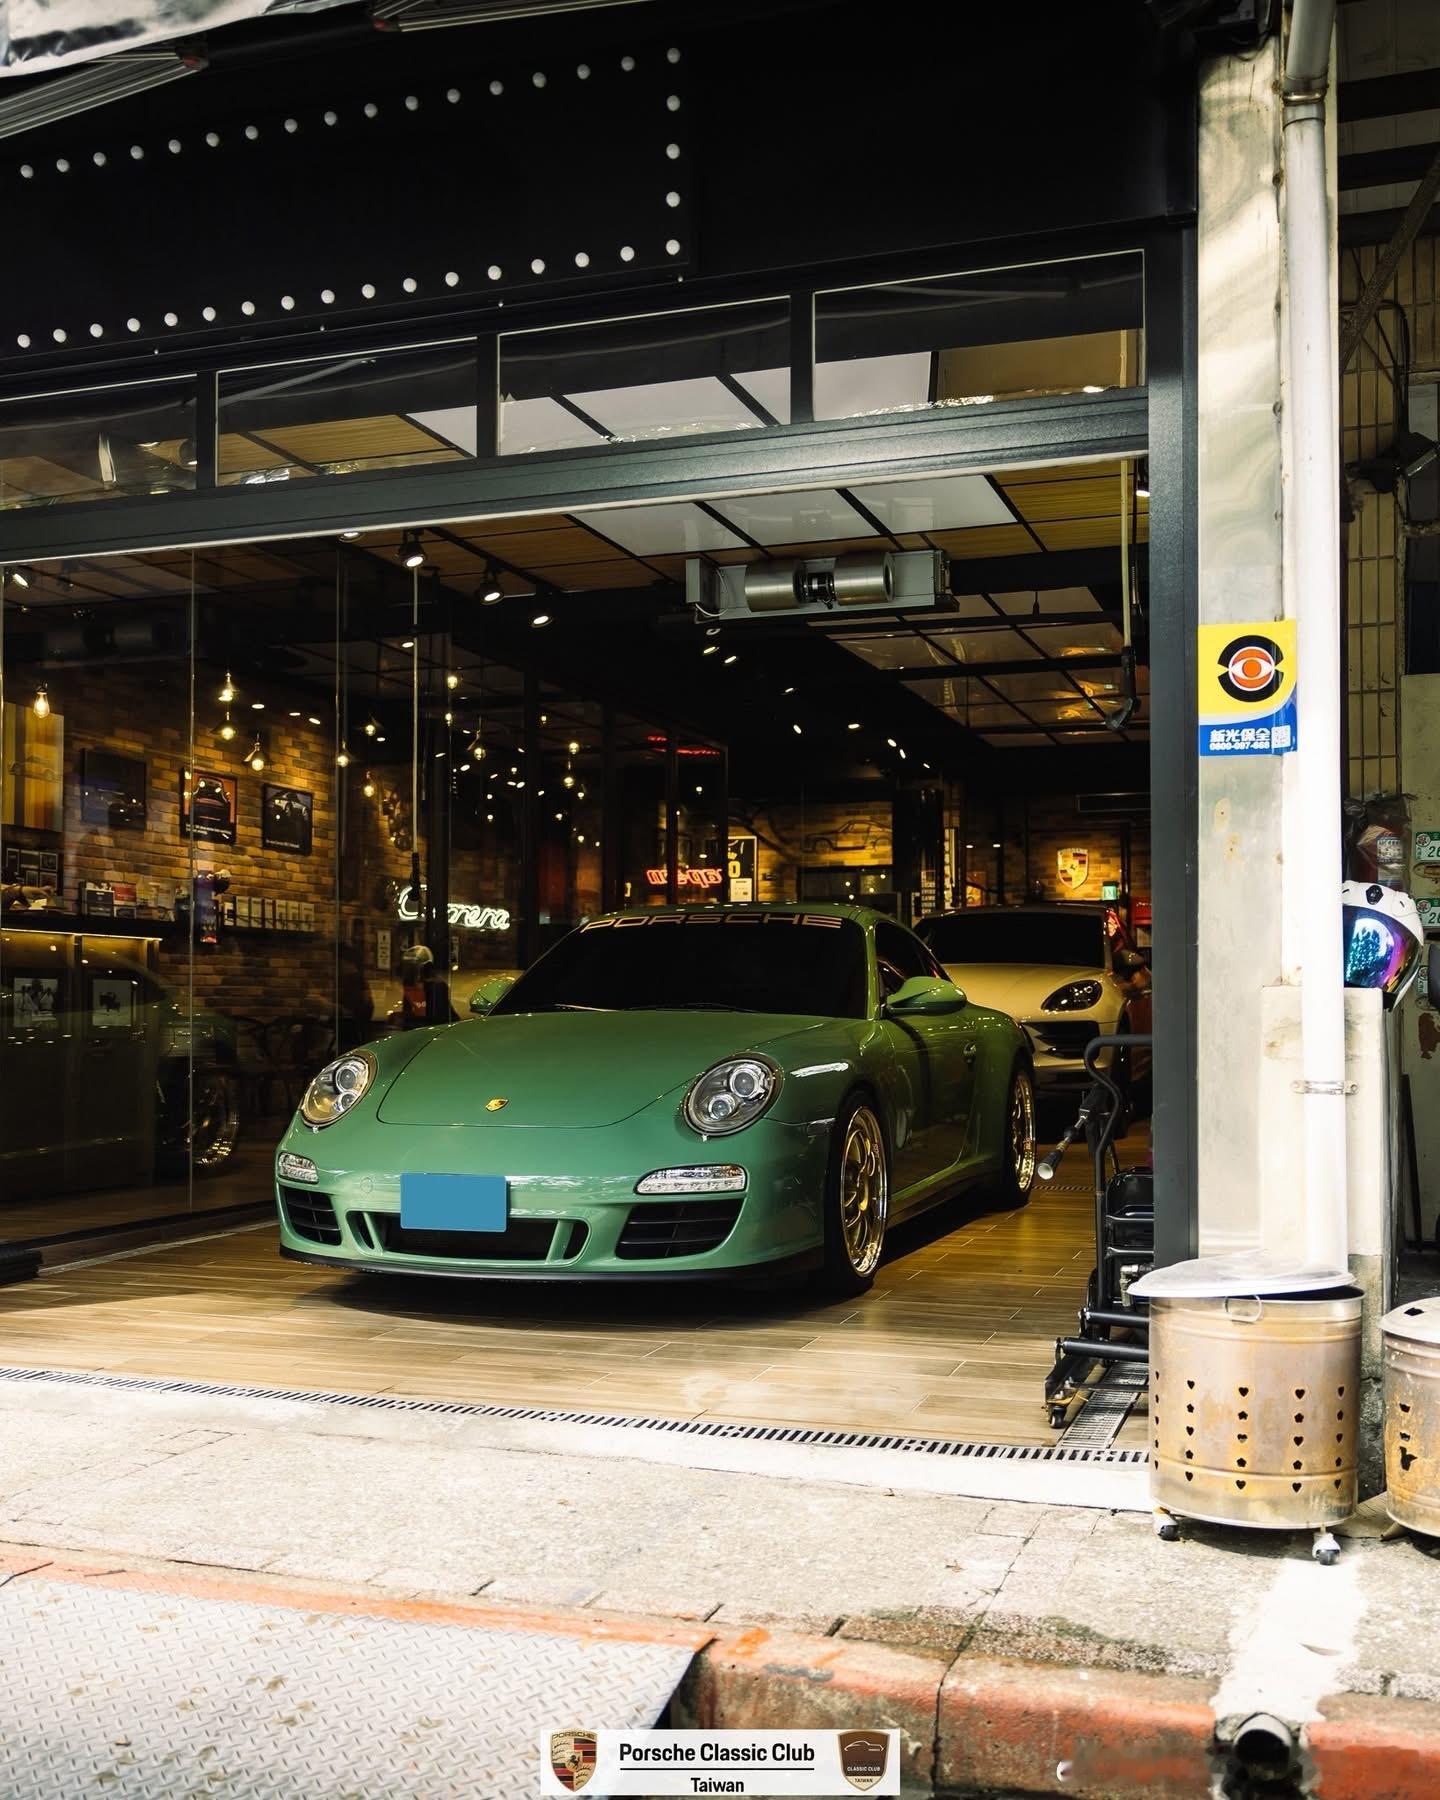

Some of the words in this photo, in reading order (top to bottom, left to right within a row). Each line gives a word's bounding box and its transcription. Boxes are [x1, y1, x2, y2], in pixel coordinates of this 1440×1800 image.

[1210, 728, 1271, 742] 新光保全
[579, 912, 843, 934] PORSCHE
